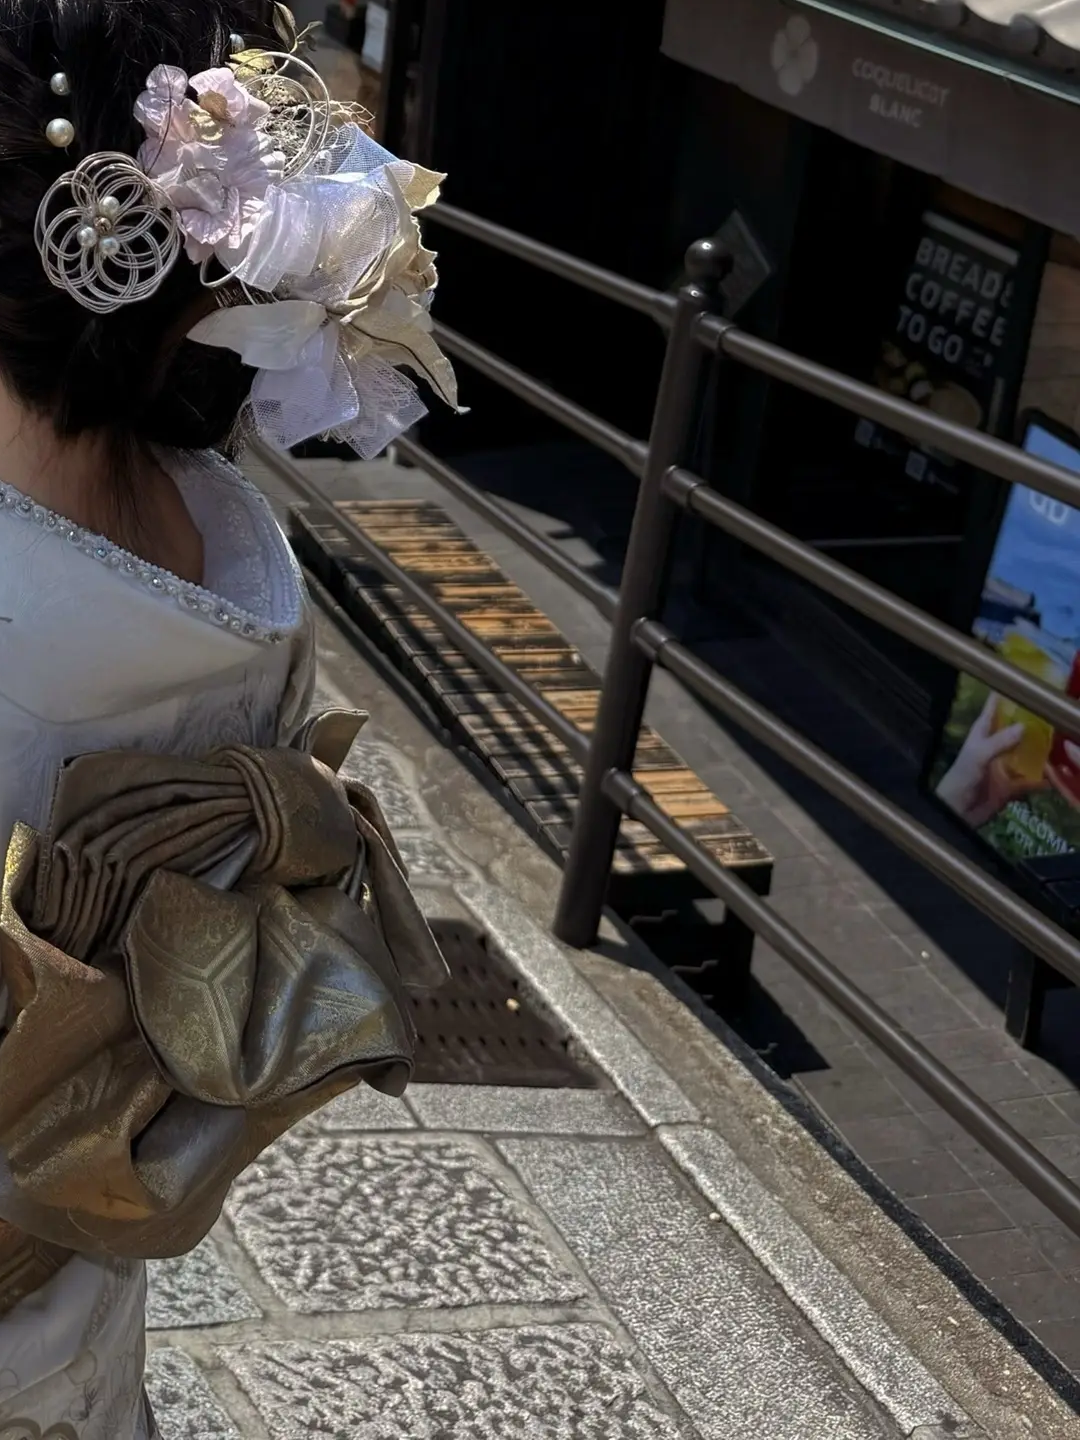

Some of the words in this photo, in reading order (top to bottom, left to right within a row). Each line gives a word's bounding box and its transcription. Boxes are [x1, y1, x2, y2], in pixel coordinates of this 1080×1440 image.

[852, 57, 951, 107] COQUELICOT
[869, 93, 923, 128] BLANC
[896, 304, 926, 343] TO
[927, 325, 964, 363] GO
[905, 272, 1008, 347] COFFEE
